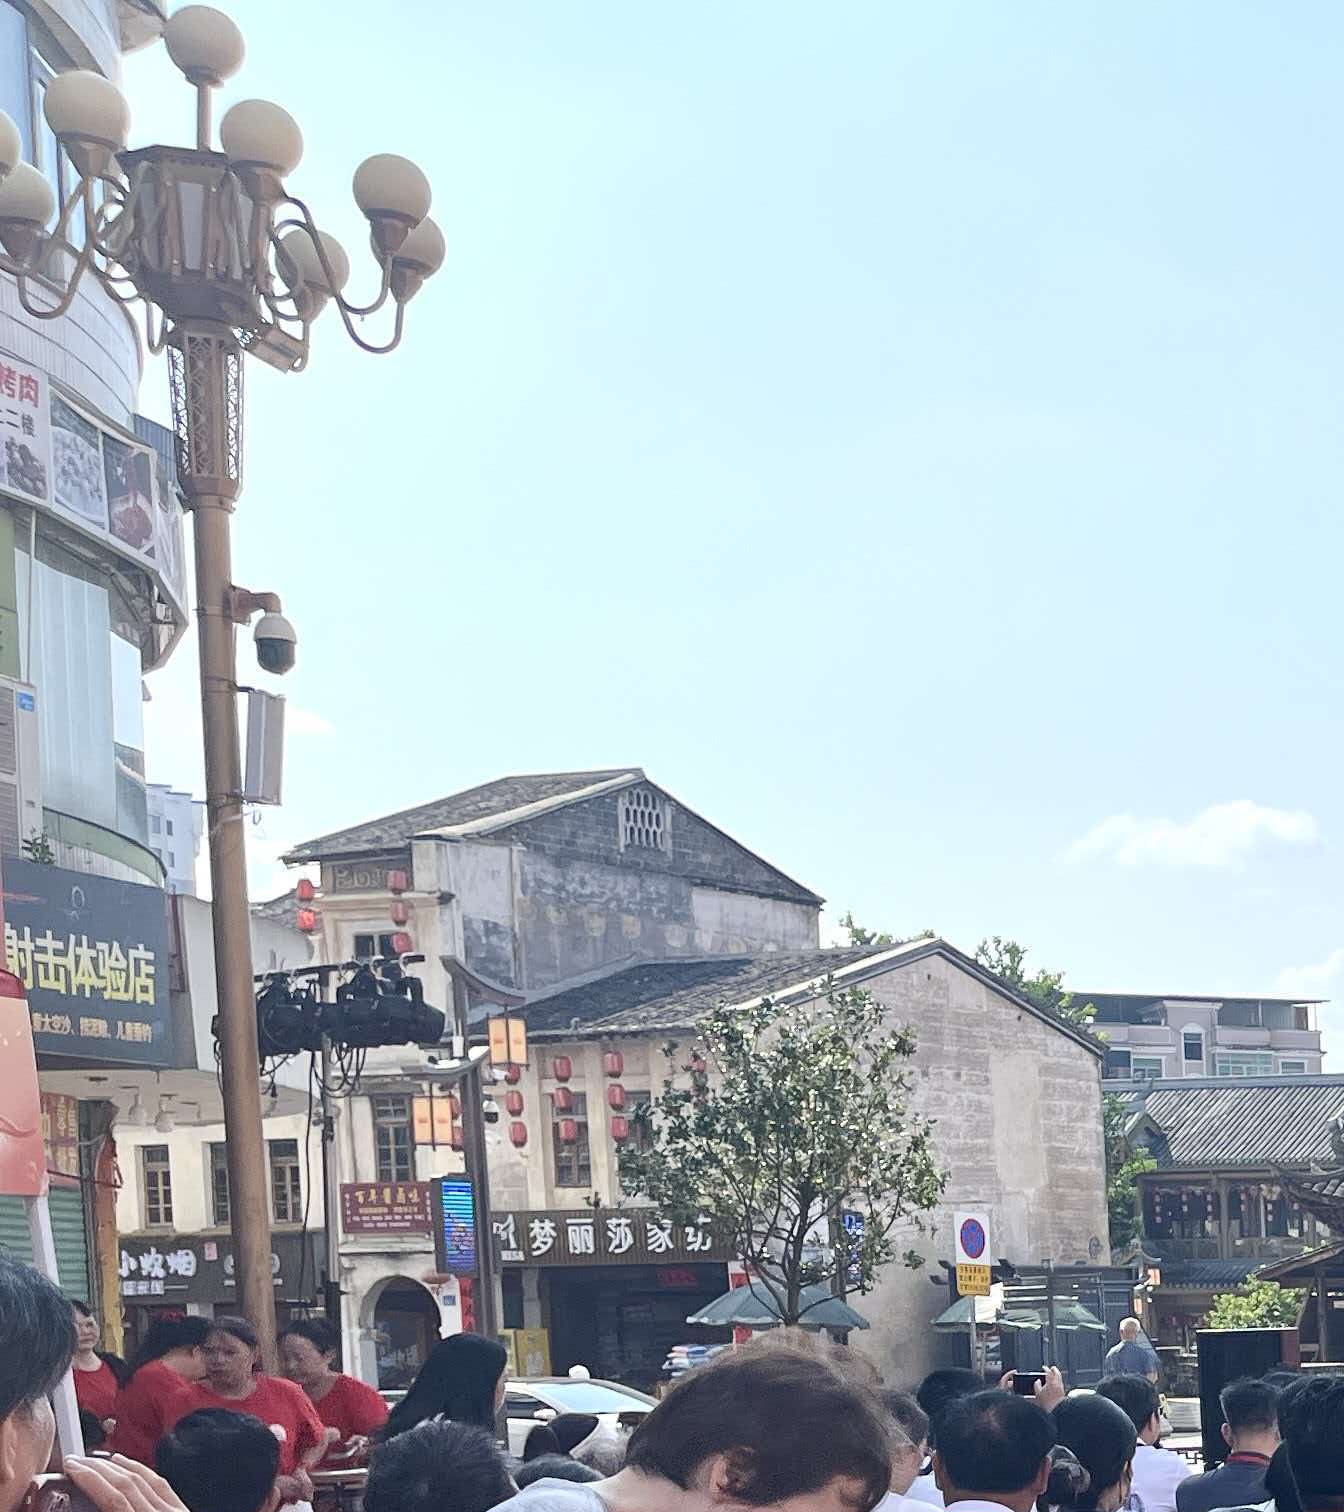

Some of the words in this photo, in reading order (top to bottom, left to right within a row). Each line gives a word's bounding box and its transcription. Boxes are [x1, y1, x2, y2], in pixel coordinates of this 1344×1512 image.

[5, 922, 155, 1005] 射击体验店
